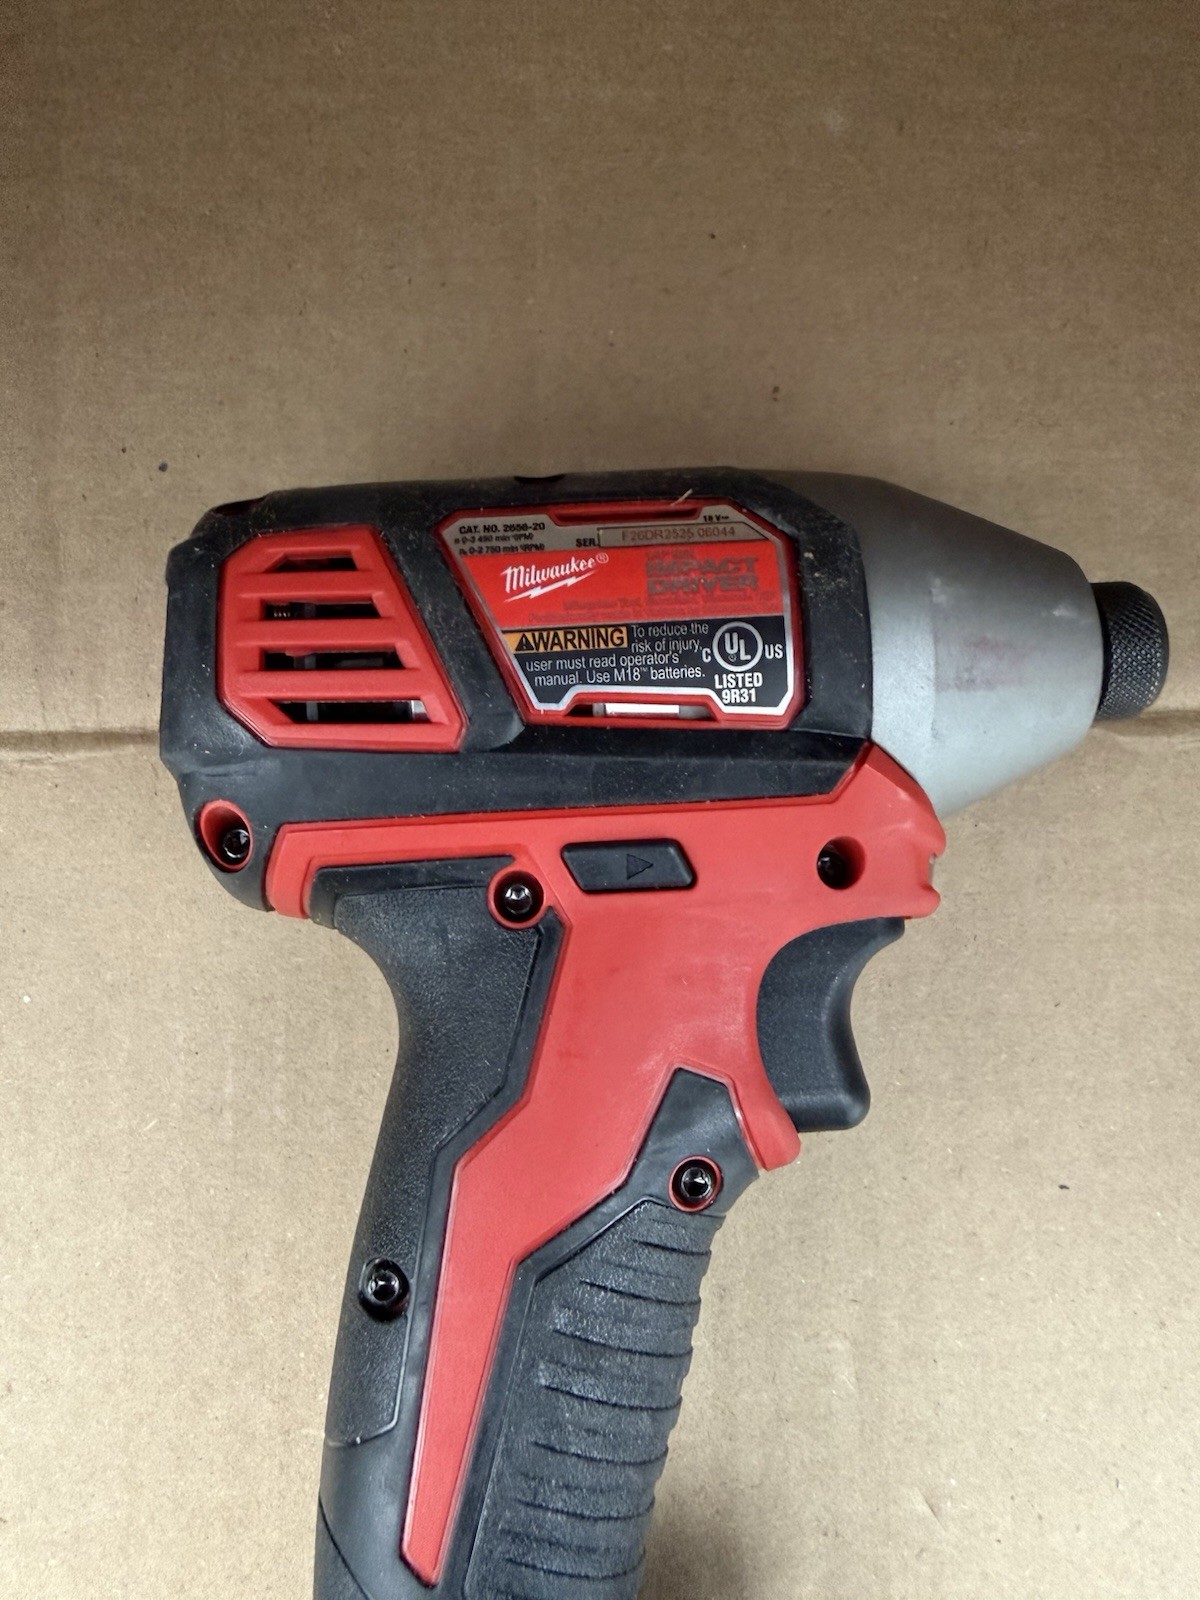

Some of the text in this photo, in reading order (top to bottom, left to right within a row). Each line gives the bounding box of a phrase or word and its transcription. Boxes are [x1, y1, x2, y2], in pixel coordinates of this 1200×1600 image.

[459, 524, 479, 534] CAT.
[483, 524, 500, 533] NO.
[697, 526, 736, 538] 06044
[631, 622, 709, 638] To reduce the
[532, 628, 624, 652] WARNING
[631, 640, 650, 653] risk
[654, 639, 666, 652] of
[724, 632, 751, 661] UL
[765, 644, 784, 659] US
[526, 651, 680, 672] user must read operator's
[534, 672, 582, 686] manual.
[586, 670, 610, 684] Use
[650, 664, 706, 680] batteries.
[714, 672, 764, 690] LISTED
[722, 688, 757, 704] 9R31
